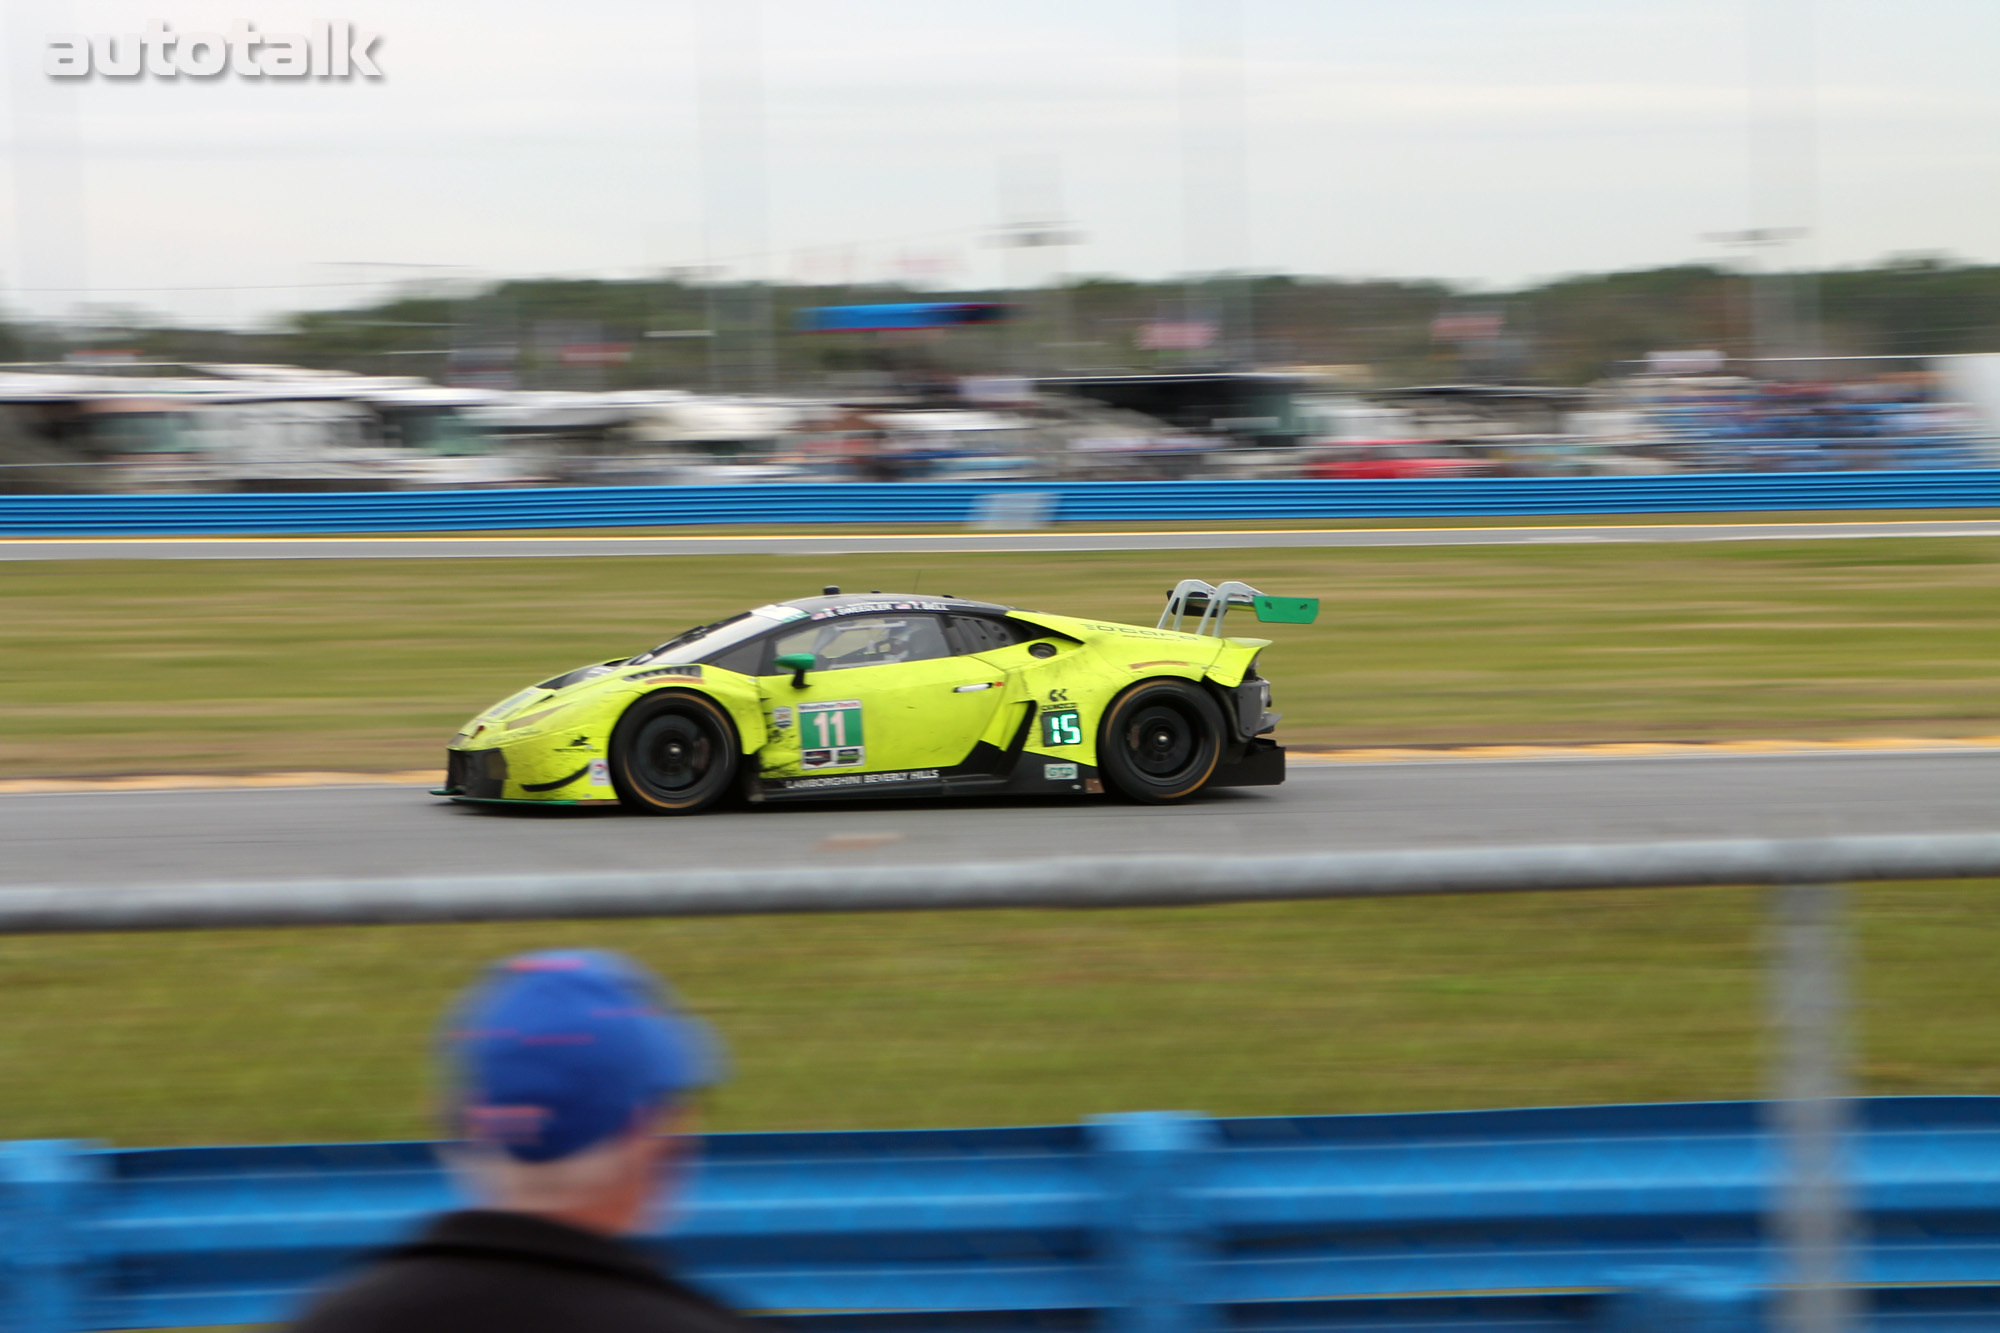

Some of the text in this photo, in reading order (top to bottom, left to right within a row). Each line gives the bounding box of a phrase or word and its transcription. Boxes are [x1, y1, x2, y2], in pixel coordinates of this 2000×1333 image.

[813, 710, 846, 747] 11
[1050, 713, 1082, 744] 15
[785, 769, 940, 789] LAMBORGHINI BEVERLY HILLS
